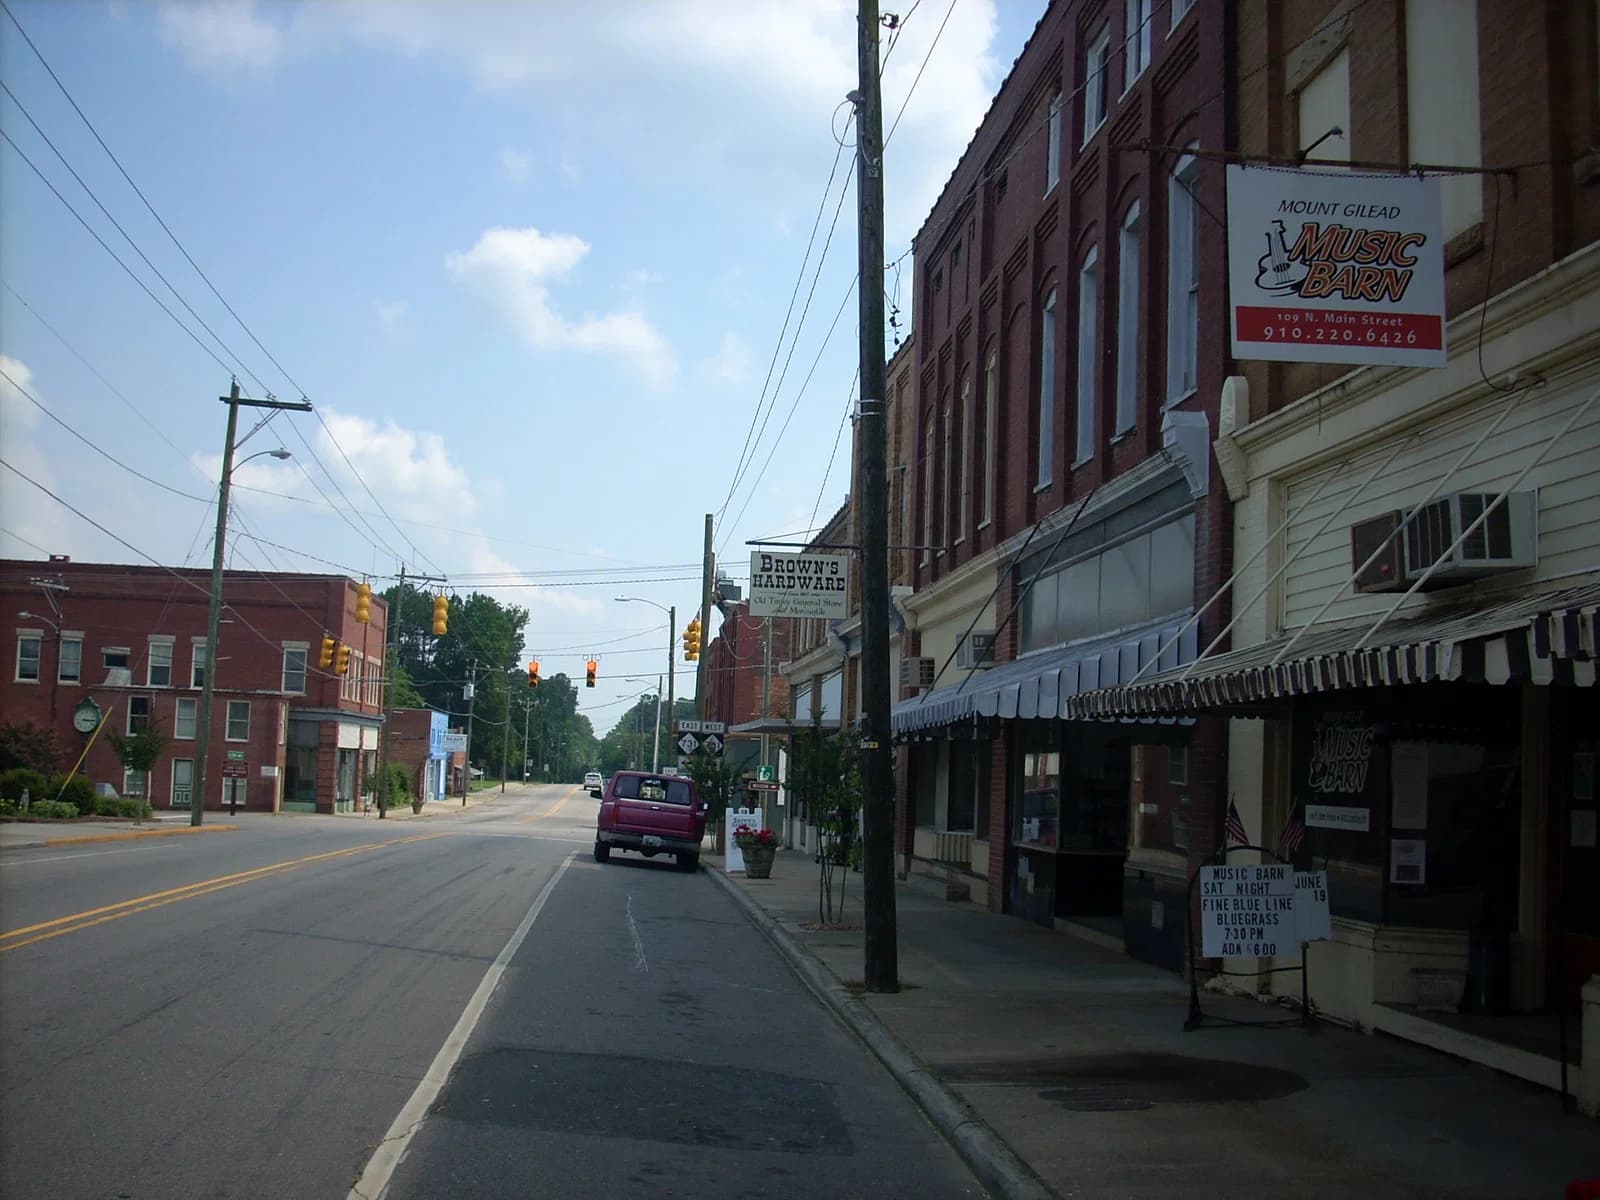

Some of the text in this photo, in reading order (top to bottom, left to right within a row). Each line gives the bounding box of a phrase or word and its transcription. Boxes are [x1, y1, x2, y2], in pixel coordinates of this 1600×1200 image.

[1277, 200, 1401, 220] MOUNT GILEAD
[1289, 222, 1425, 267] MUSIC
[1299, 260, 1413, 302] BARN
[1277, 313, 1402, 326] 109 N. Main Street
[1264, 326, 1417, 345] 910.220.6426
[760, 554, 839, 575] BROWN'S
[752, 574, 846, 591] HARDWARE
[681, 721, 697, 730] EAST
[704, 723, 721, 732] WEST
[1324, 726, 1376, 761] MUSIC
[1322, 759, 1368, 793] BARN
[1213, 867, 1284, 881] MUSIC BARN
[1203, 882, 1271, 896] SAT NIGHT
[1295, 876, 1322, 889] JUNE
[1313, 890, 1327, 901] 19
[1202, 898, 1293, 911] FINE BLUE LINE
[1217, 913, 1279, 926] BLUEGRASS
[1250, 927, 1264, 940] PM
